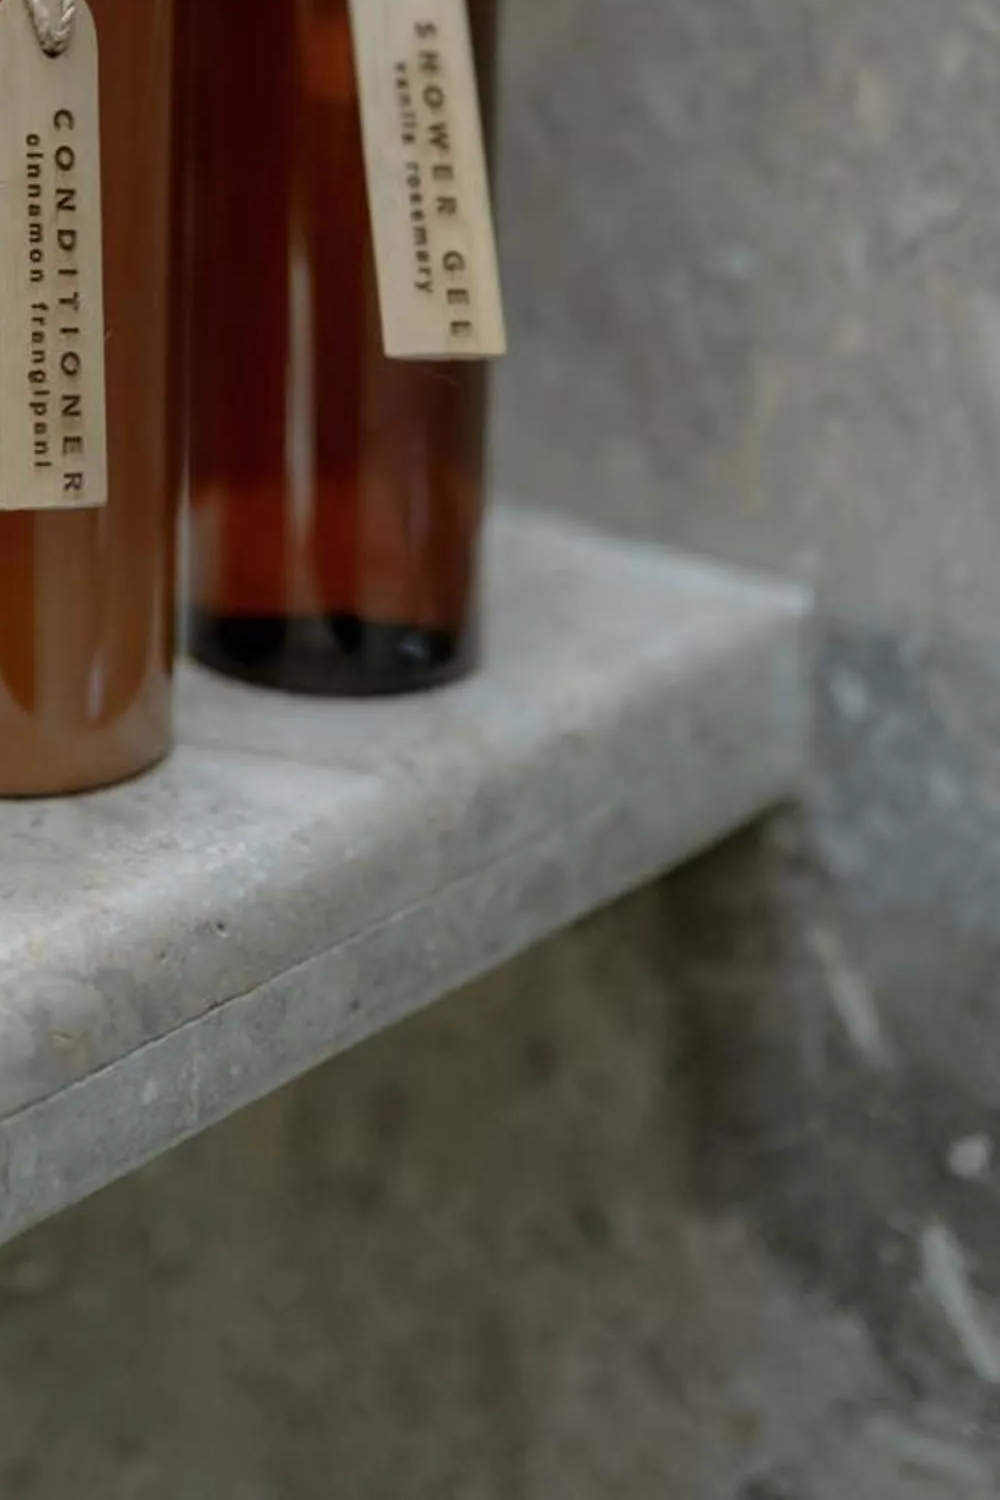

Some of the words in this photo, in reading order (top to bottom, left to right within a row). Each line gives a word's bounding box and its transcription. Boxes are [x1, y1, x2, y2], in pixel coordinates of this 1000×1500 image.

[26, 133, 44, 283] cinnamon
[405, 160, 434, 294] rosemary
[413, 21, 457, 216] SHOWER
[442, 250, 472, 336] GEL
[53, 108, 84, 491] CONDITIONER
[27, 301, 53, 468] frangipani
